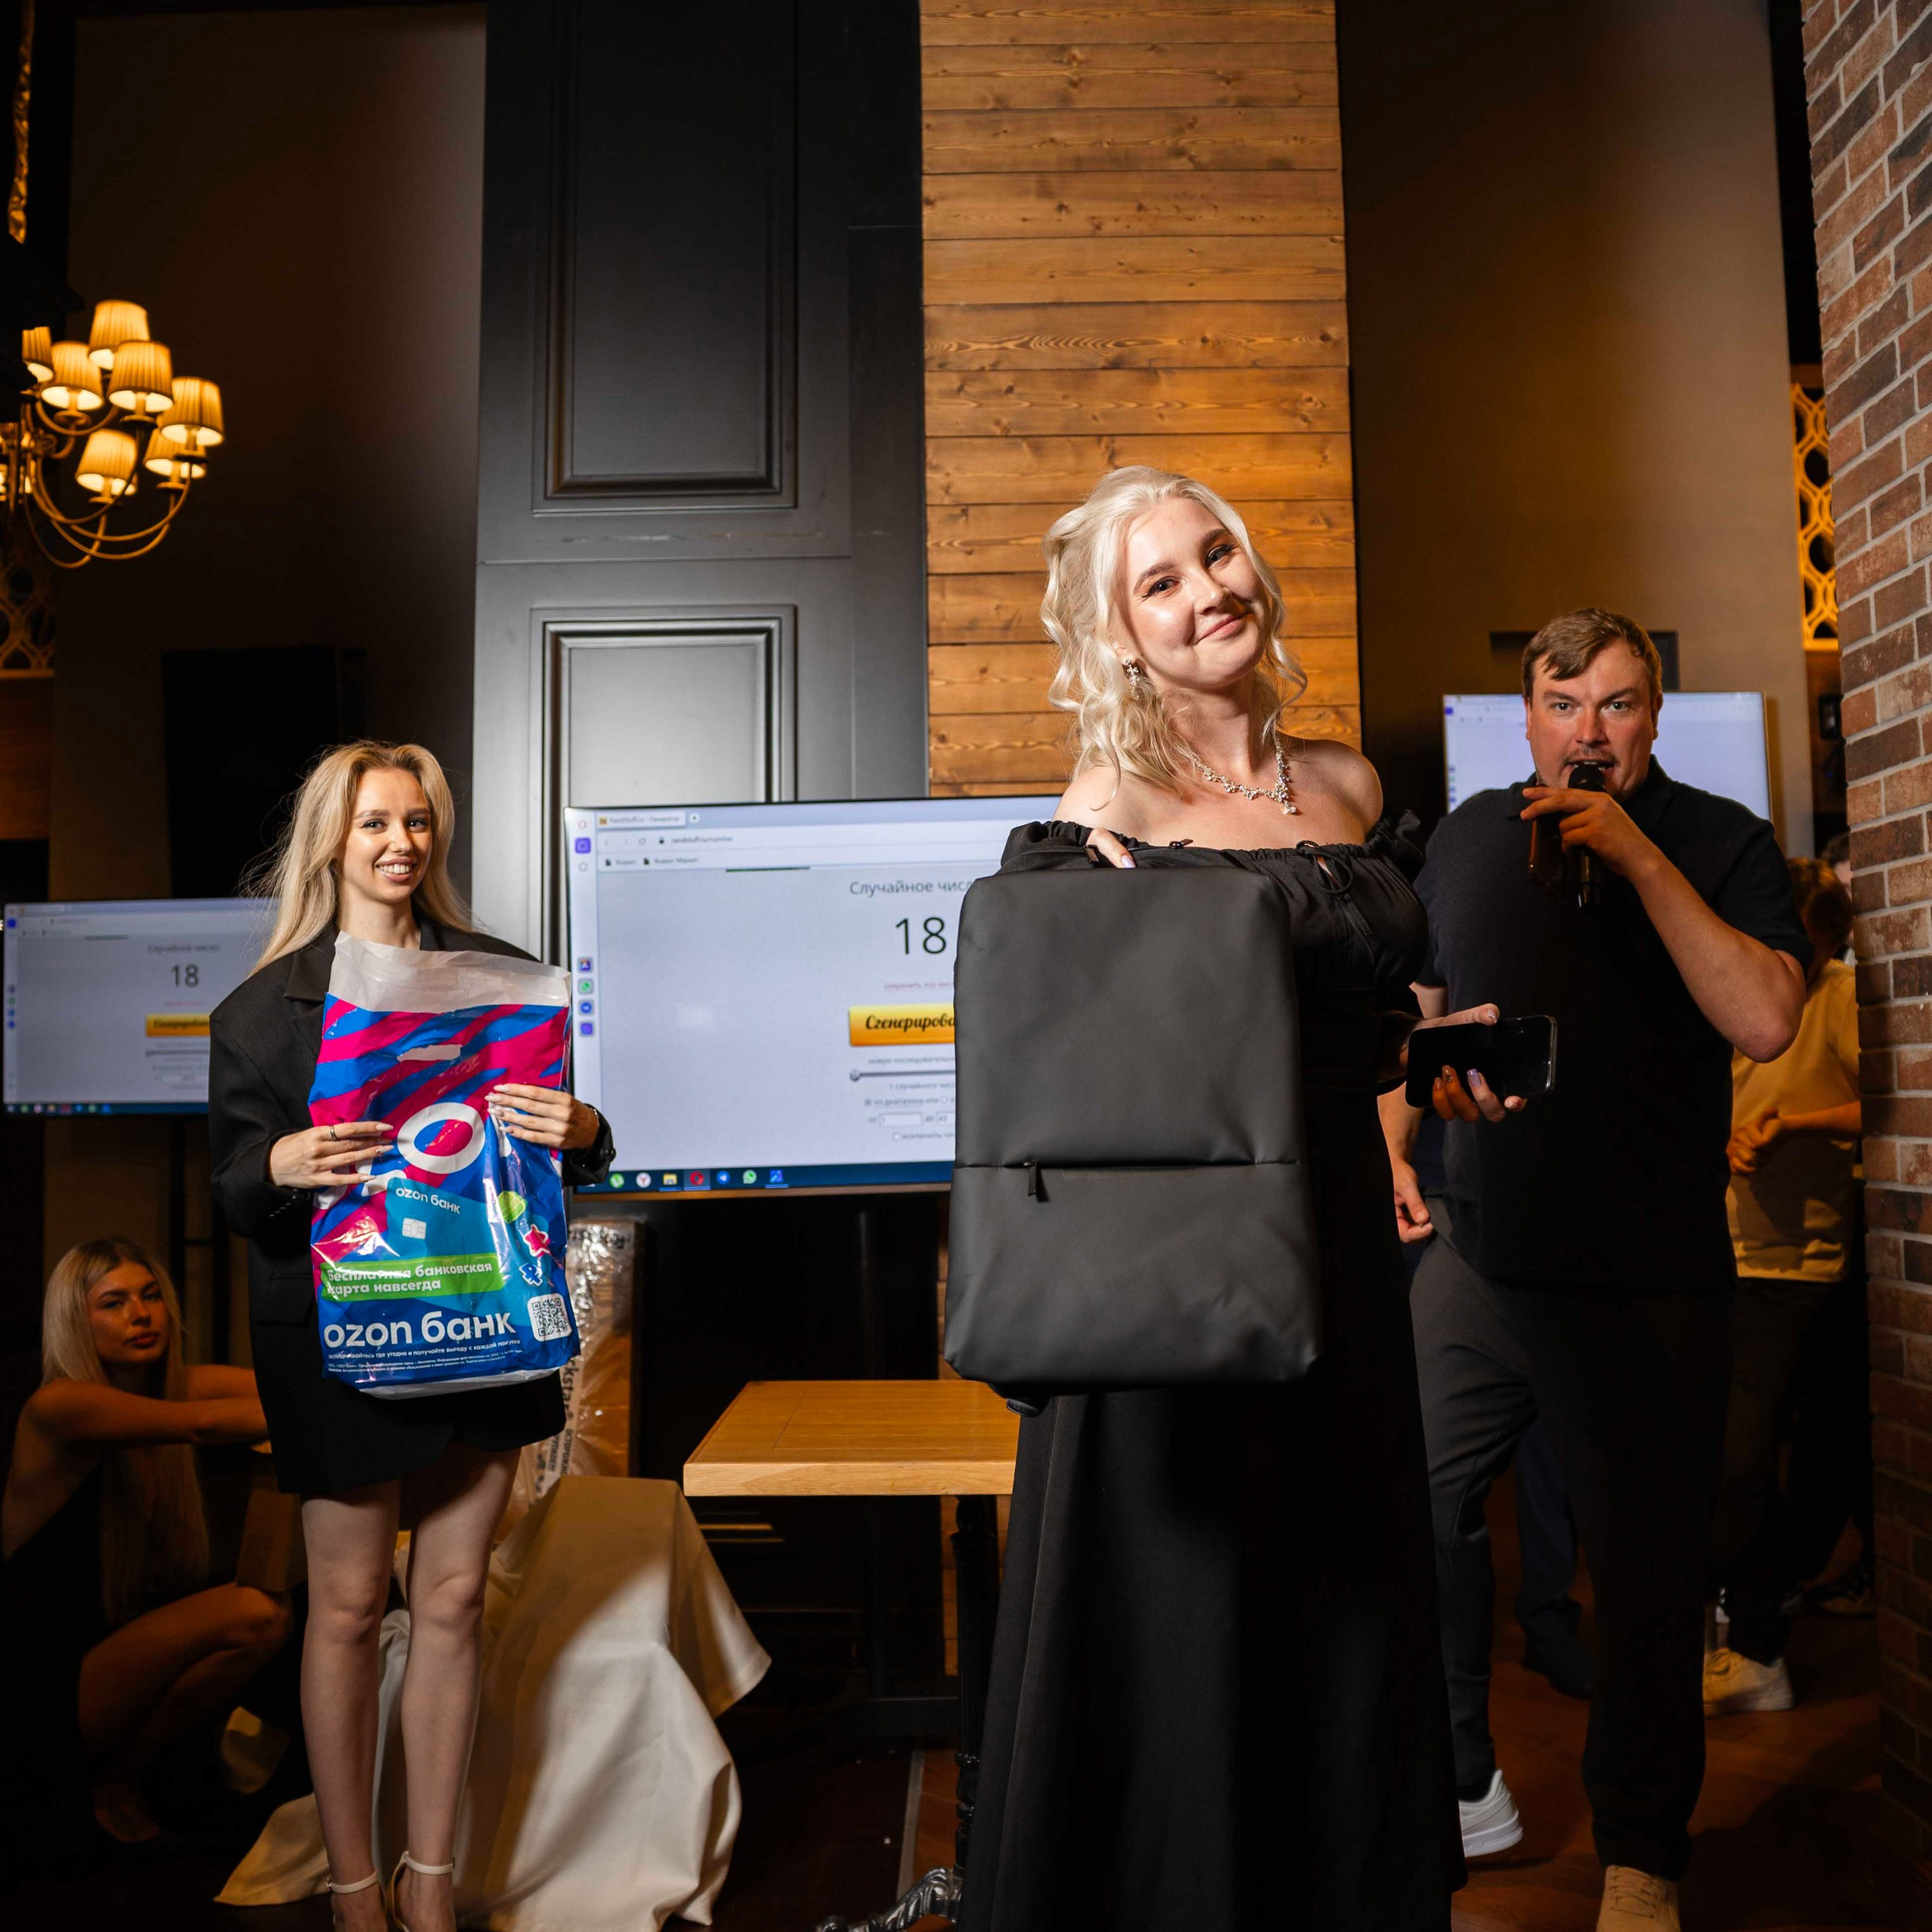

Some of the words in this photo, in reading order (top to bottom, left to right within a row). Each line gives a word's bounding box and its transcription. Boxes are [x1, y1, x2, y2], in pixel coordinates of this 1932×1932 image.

[849, 880, 934, 897] Случайное
[938, 880, 971, 892] числ
[896, 917, 946, 955] 18
[172, 964, 199, 987] 18
[866, 1013, 955, 1032] Сгенерирова
[395, 1187, 428, 1203] ozon
[430, 1194, 460, 1214] банк
[415, 1262, 493, 1278] банковская
[374, 1278, 441, 1293] навсегда
[324, 1320, 413, 1349] ozon
[421, 1311, 518, 1343] банк
[413, 1347, 445, 1356] получайте
[473, 1342, 497, 1351] каждой
